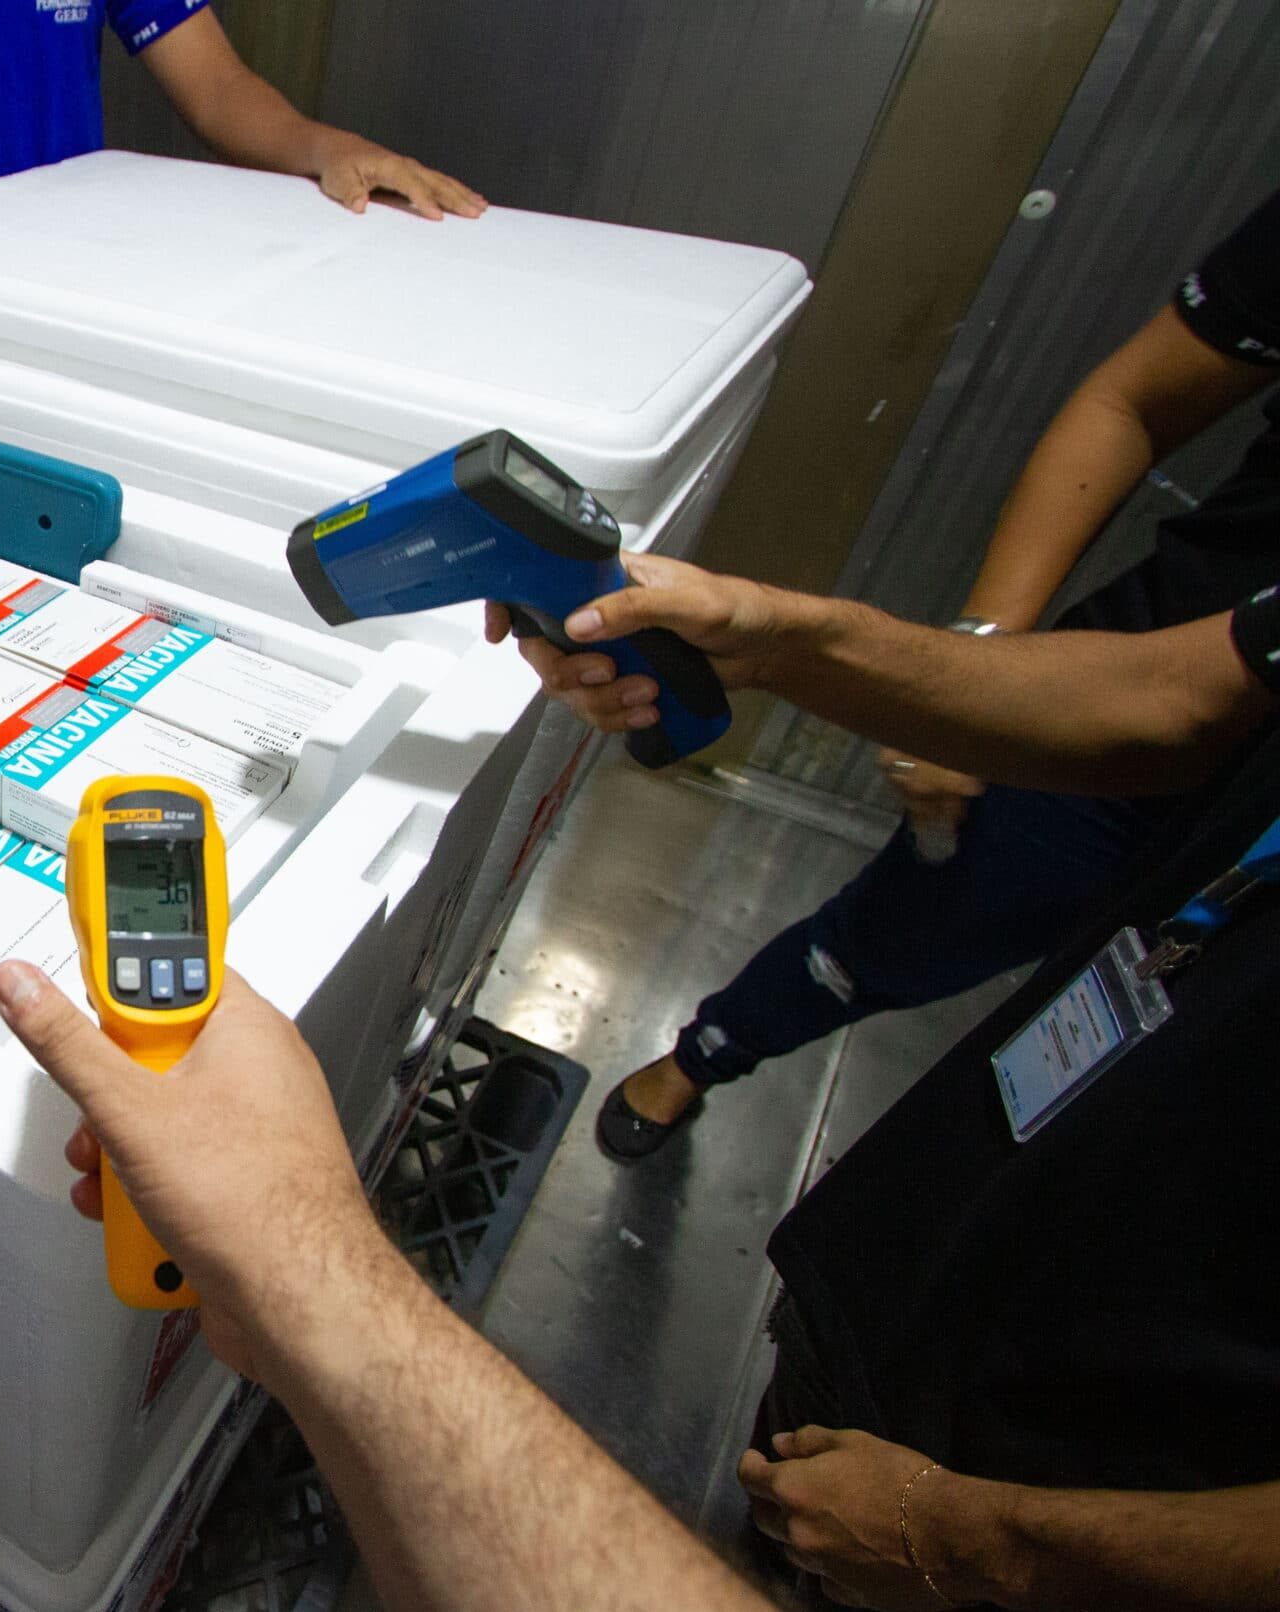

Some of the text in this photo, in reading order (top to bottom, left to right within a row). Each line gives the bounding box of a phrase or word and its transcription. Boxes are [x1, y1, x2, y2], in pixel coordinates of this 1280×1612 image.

[104, 626, 203, 693] VACINA
[4, 698, 119, 778] VACINA
[108, 811, 158, 821] FLUKE
[163, 811, 177, 820] 62
